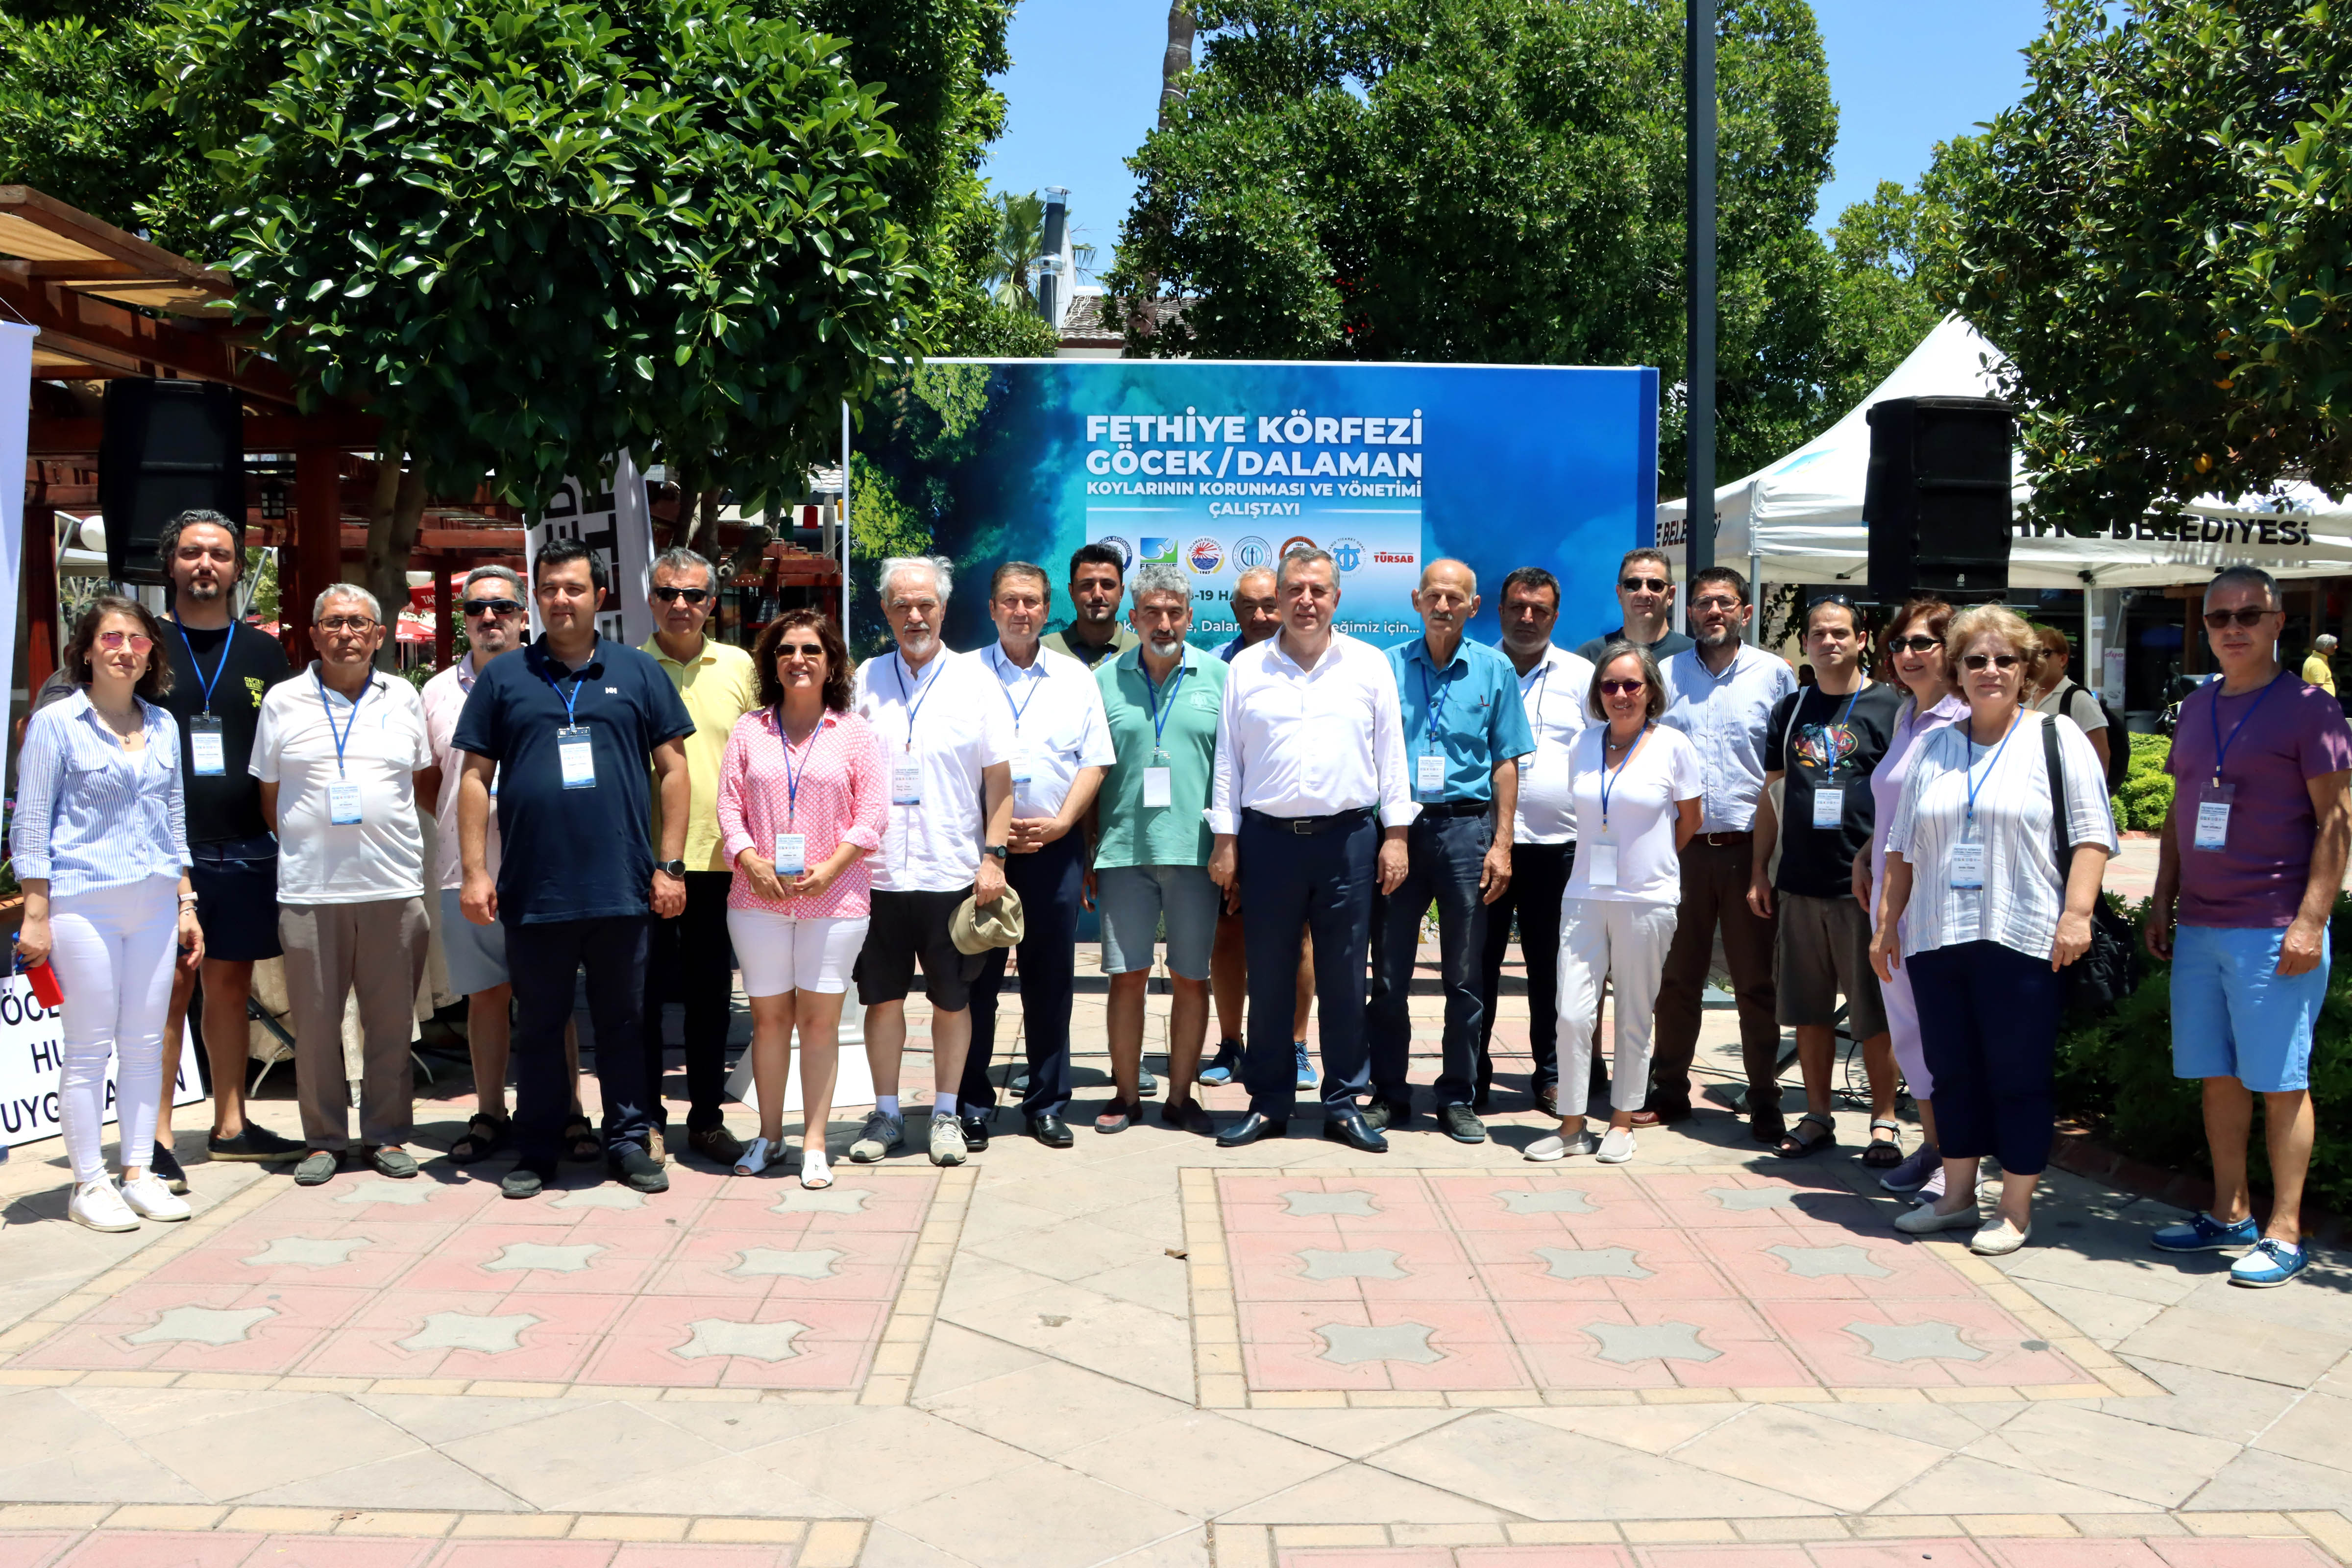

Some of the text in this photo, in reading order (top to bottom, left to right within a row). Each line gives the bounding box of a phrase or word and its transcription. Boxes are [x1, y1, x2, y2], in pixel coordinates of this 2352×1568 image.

[1087, 406, 1422, 444] FETHİYE KÖRFEZİ
[1086, 480, 1421, 497] KOYLARININ KORUNMASI VE YÖNETİMİ
[1209, 502, 1299, 519] ÇALIŞTAYI
[1373, 553, 1414, 563] TÜRSAB
[1384, 621, 1420, 636] için...
